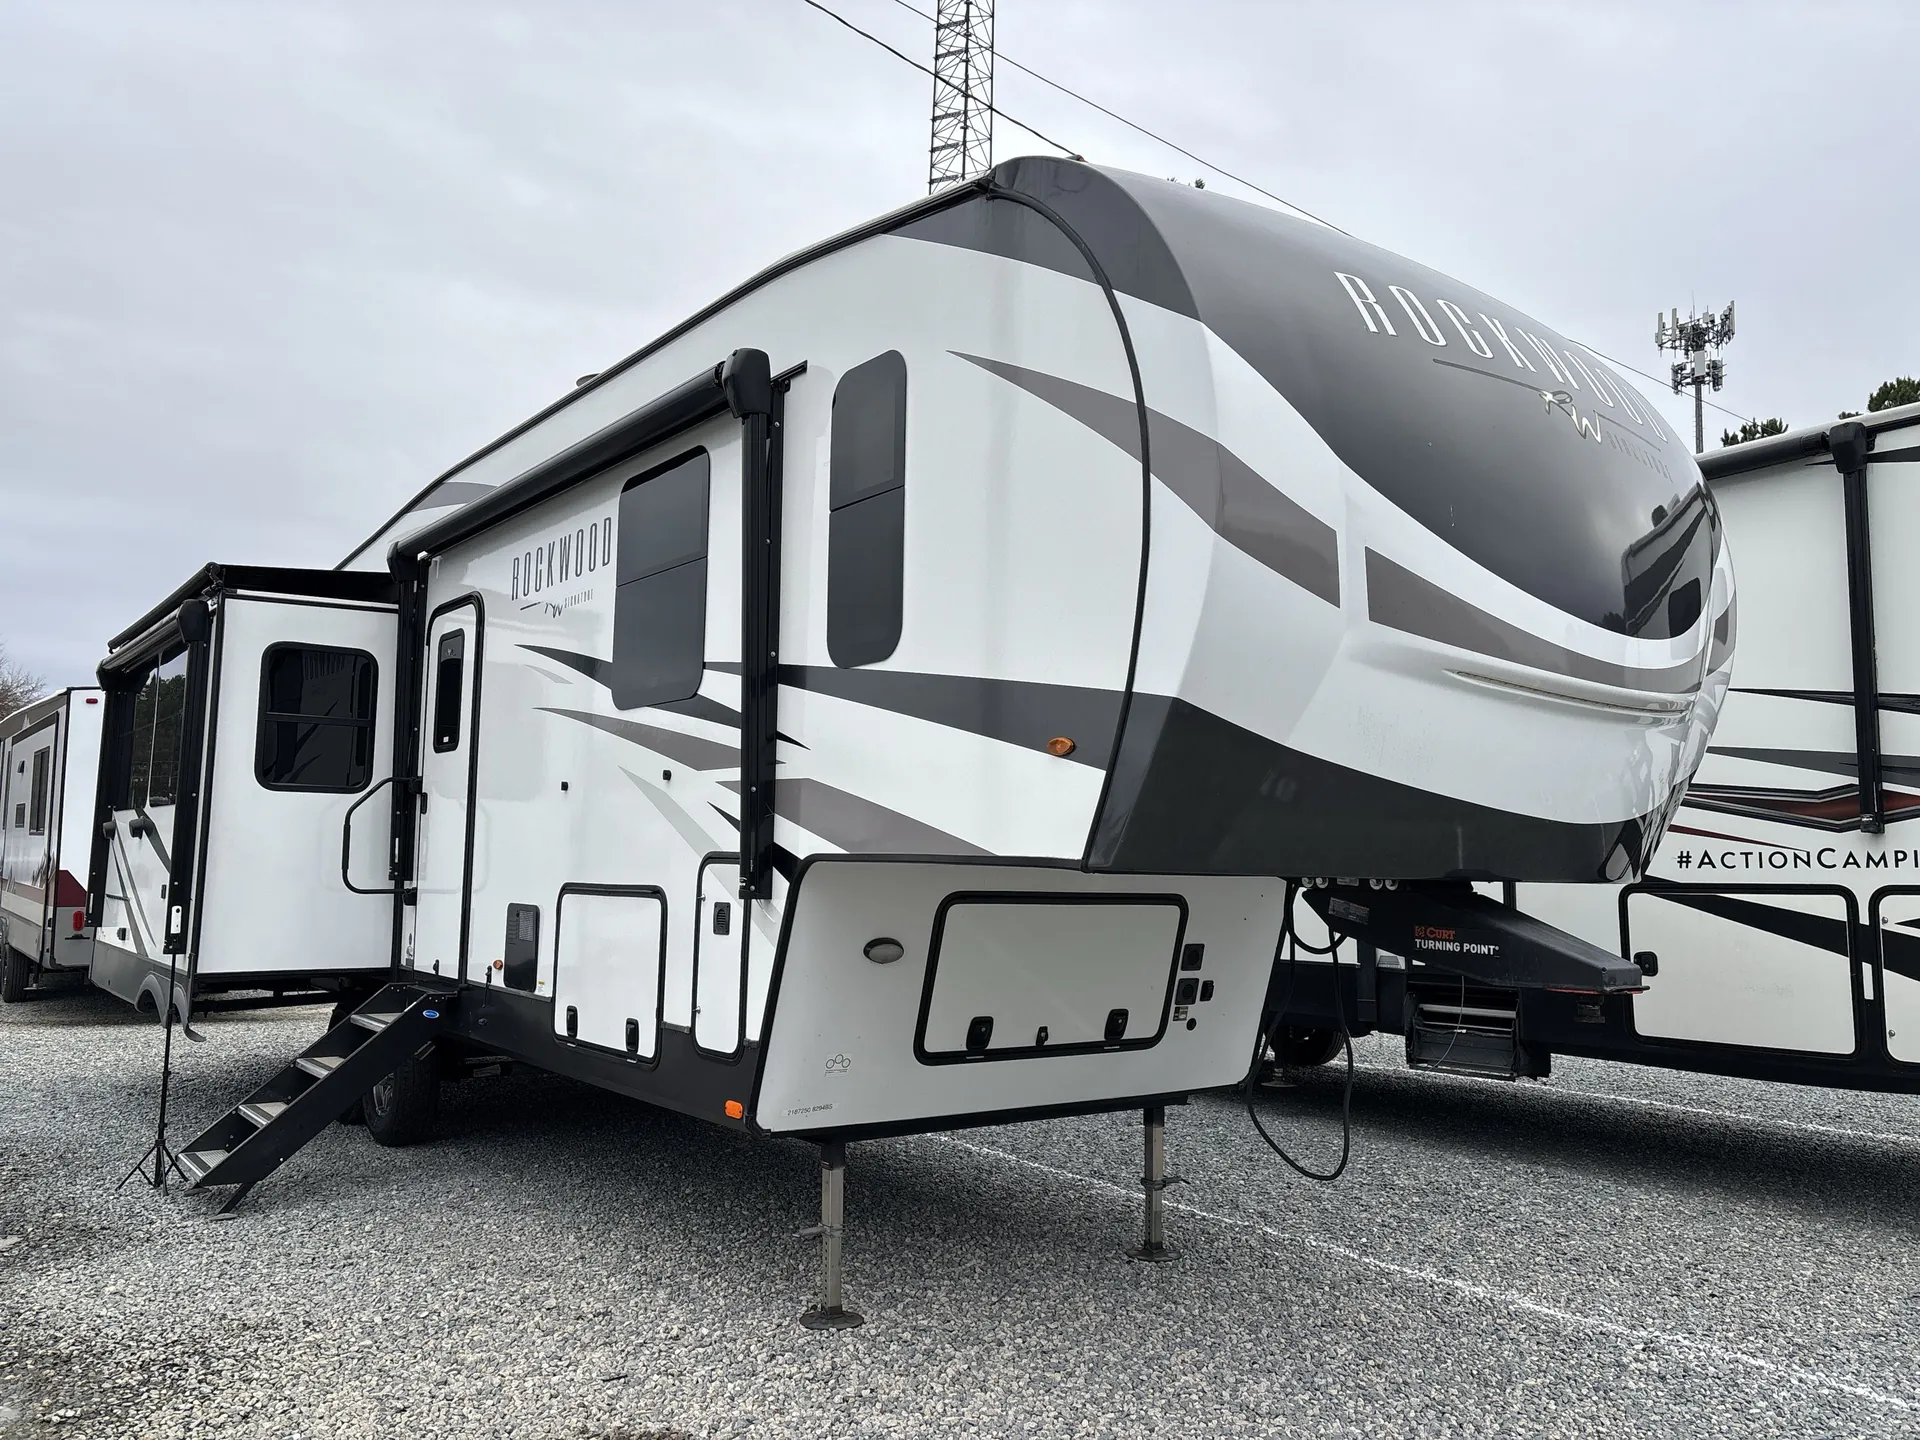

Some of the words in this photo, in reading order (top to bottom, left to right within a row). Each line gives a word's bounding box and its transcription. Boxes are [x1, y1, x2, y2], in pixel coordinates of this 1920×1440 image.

[1334, 271, 1668, 443] ROCKWOOD
[511, 516, 612, 601] ROCKWOOD
[1415, 939, 1461, 952] TURNING
